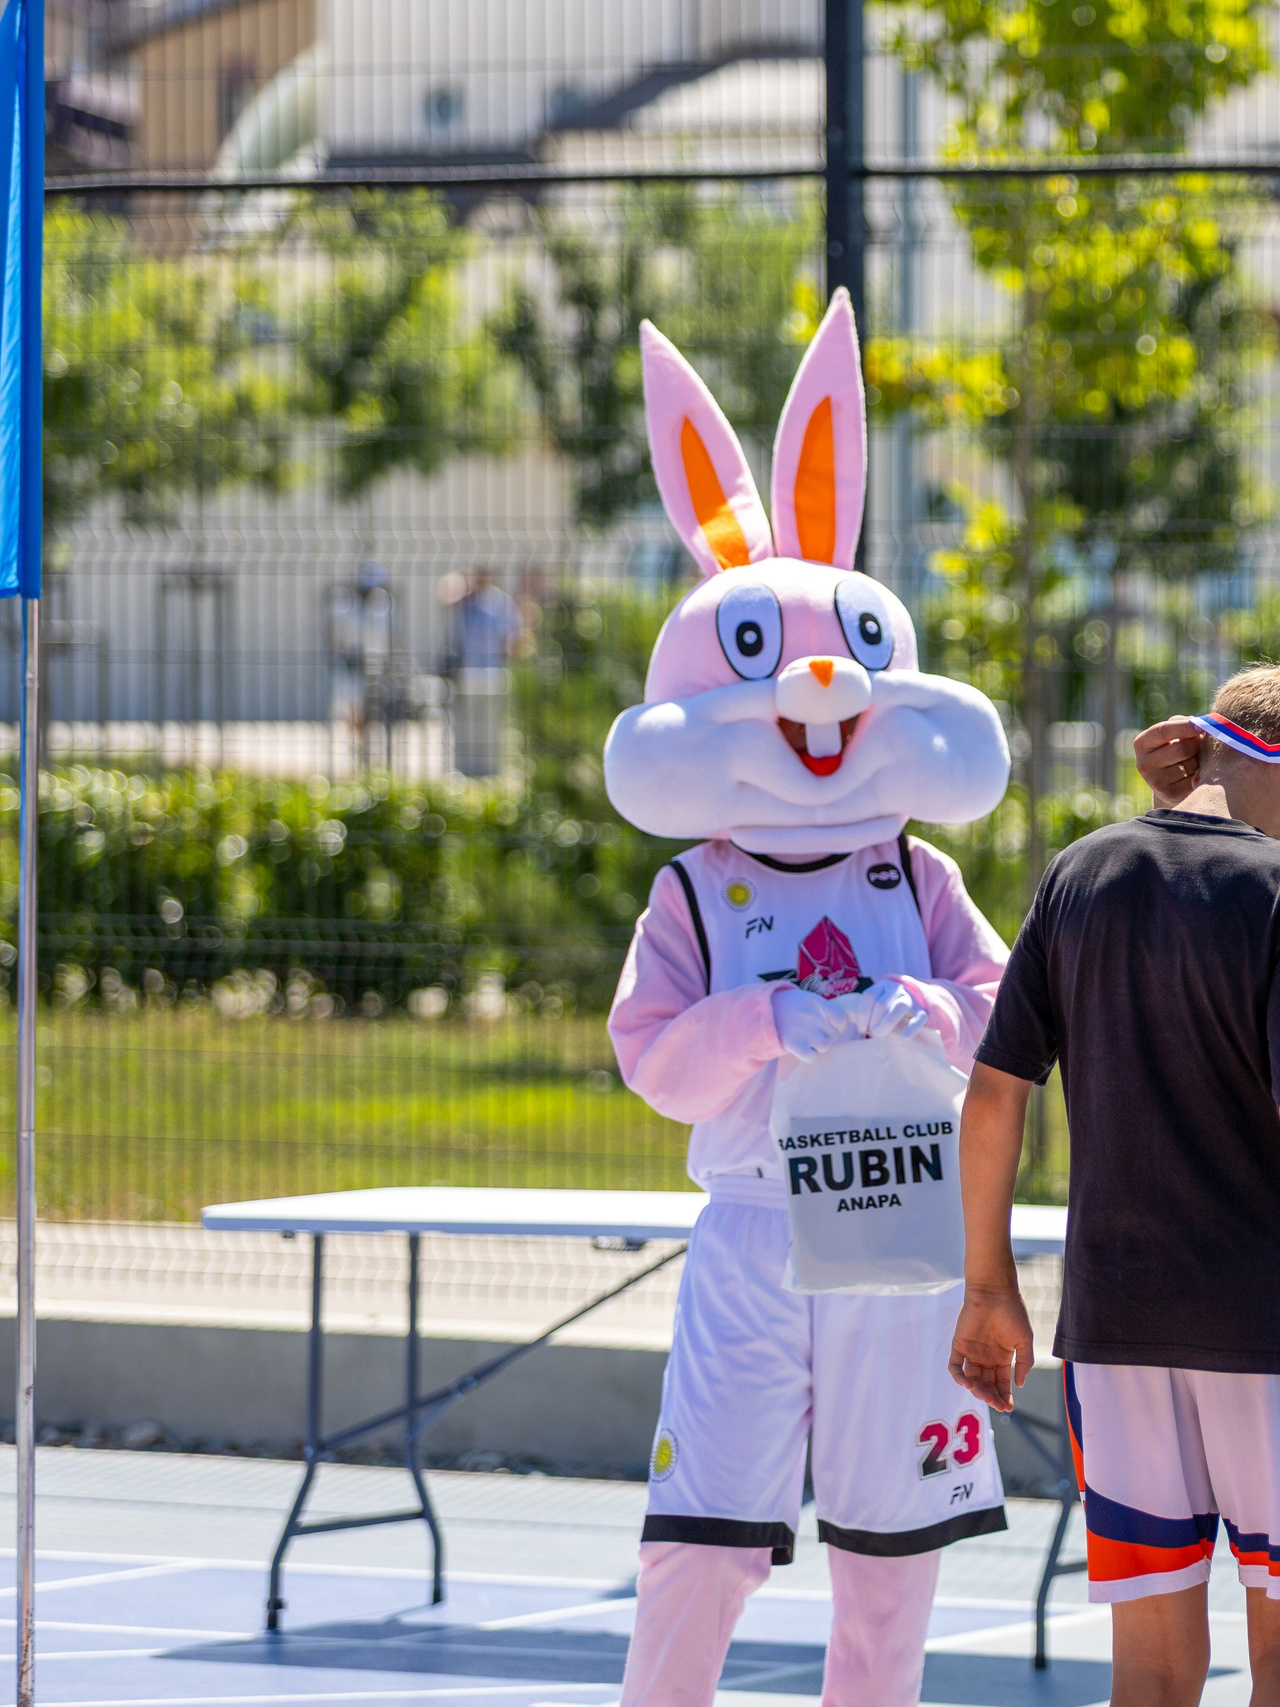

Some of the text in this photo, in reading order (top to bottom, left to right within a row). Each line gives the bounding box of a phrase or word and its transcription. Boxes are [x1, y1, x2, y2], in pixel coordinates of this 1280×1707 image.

[902, 1121, 953, 1139] CLUB
[788, 1143, 943, 1195] RUBIN
[836, 1193, 902, 1213] ANAPA
[915, 1410, 984, 1481] 23
